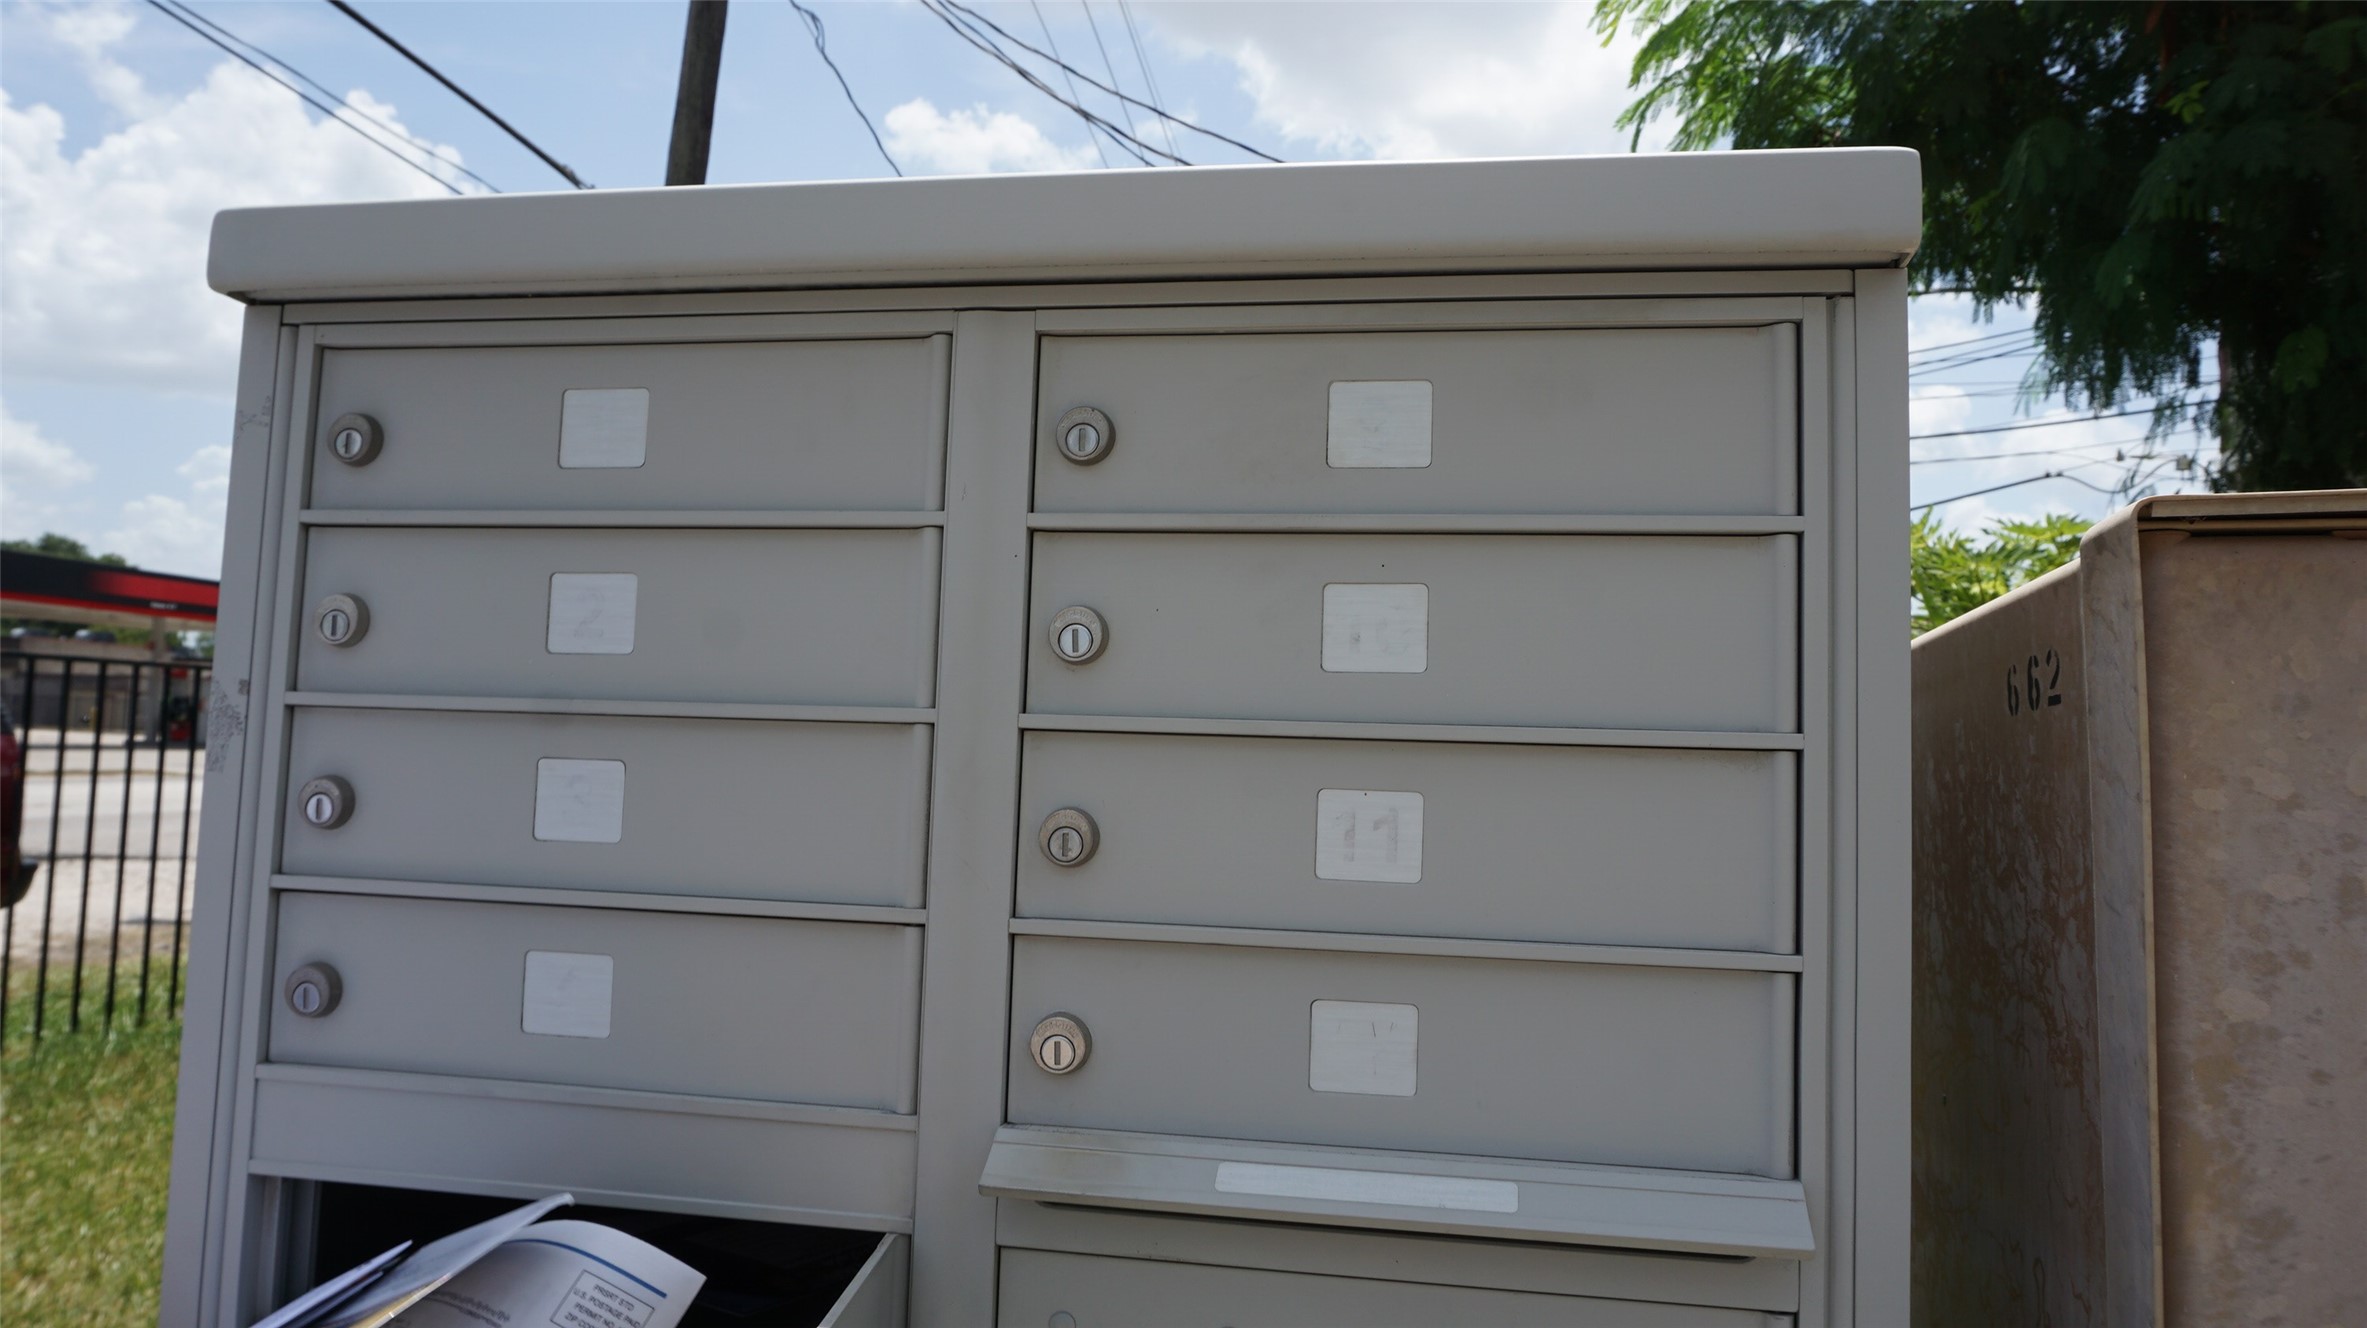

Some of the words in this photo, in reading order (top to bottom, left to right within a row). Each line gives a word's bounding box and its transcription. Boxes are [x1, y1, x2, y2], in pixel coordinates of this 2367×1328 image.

[2006, 648, 2062, 717] 662
[1335, 806, 1399, 863] 11
[574, 1302, 603, 1321] PERMIT
[589, 1295, 624, 1320] POSTAGE
